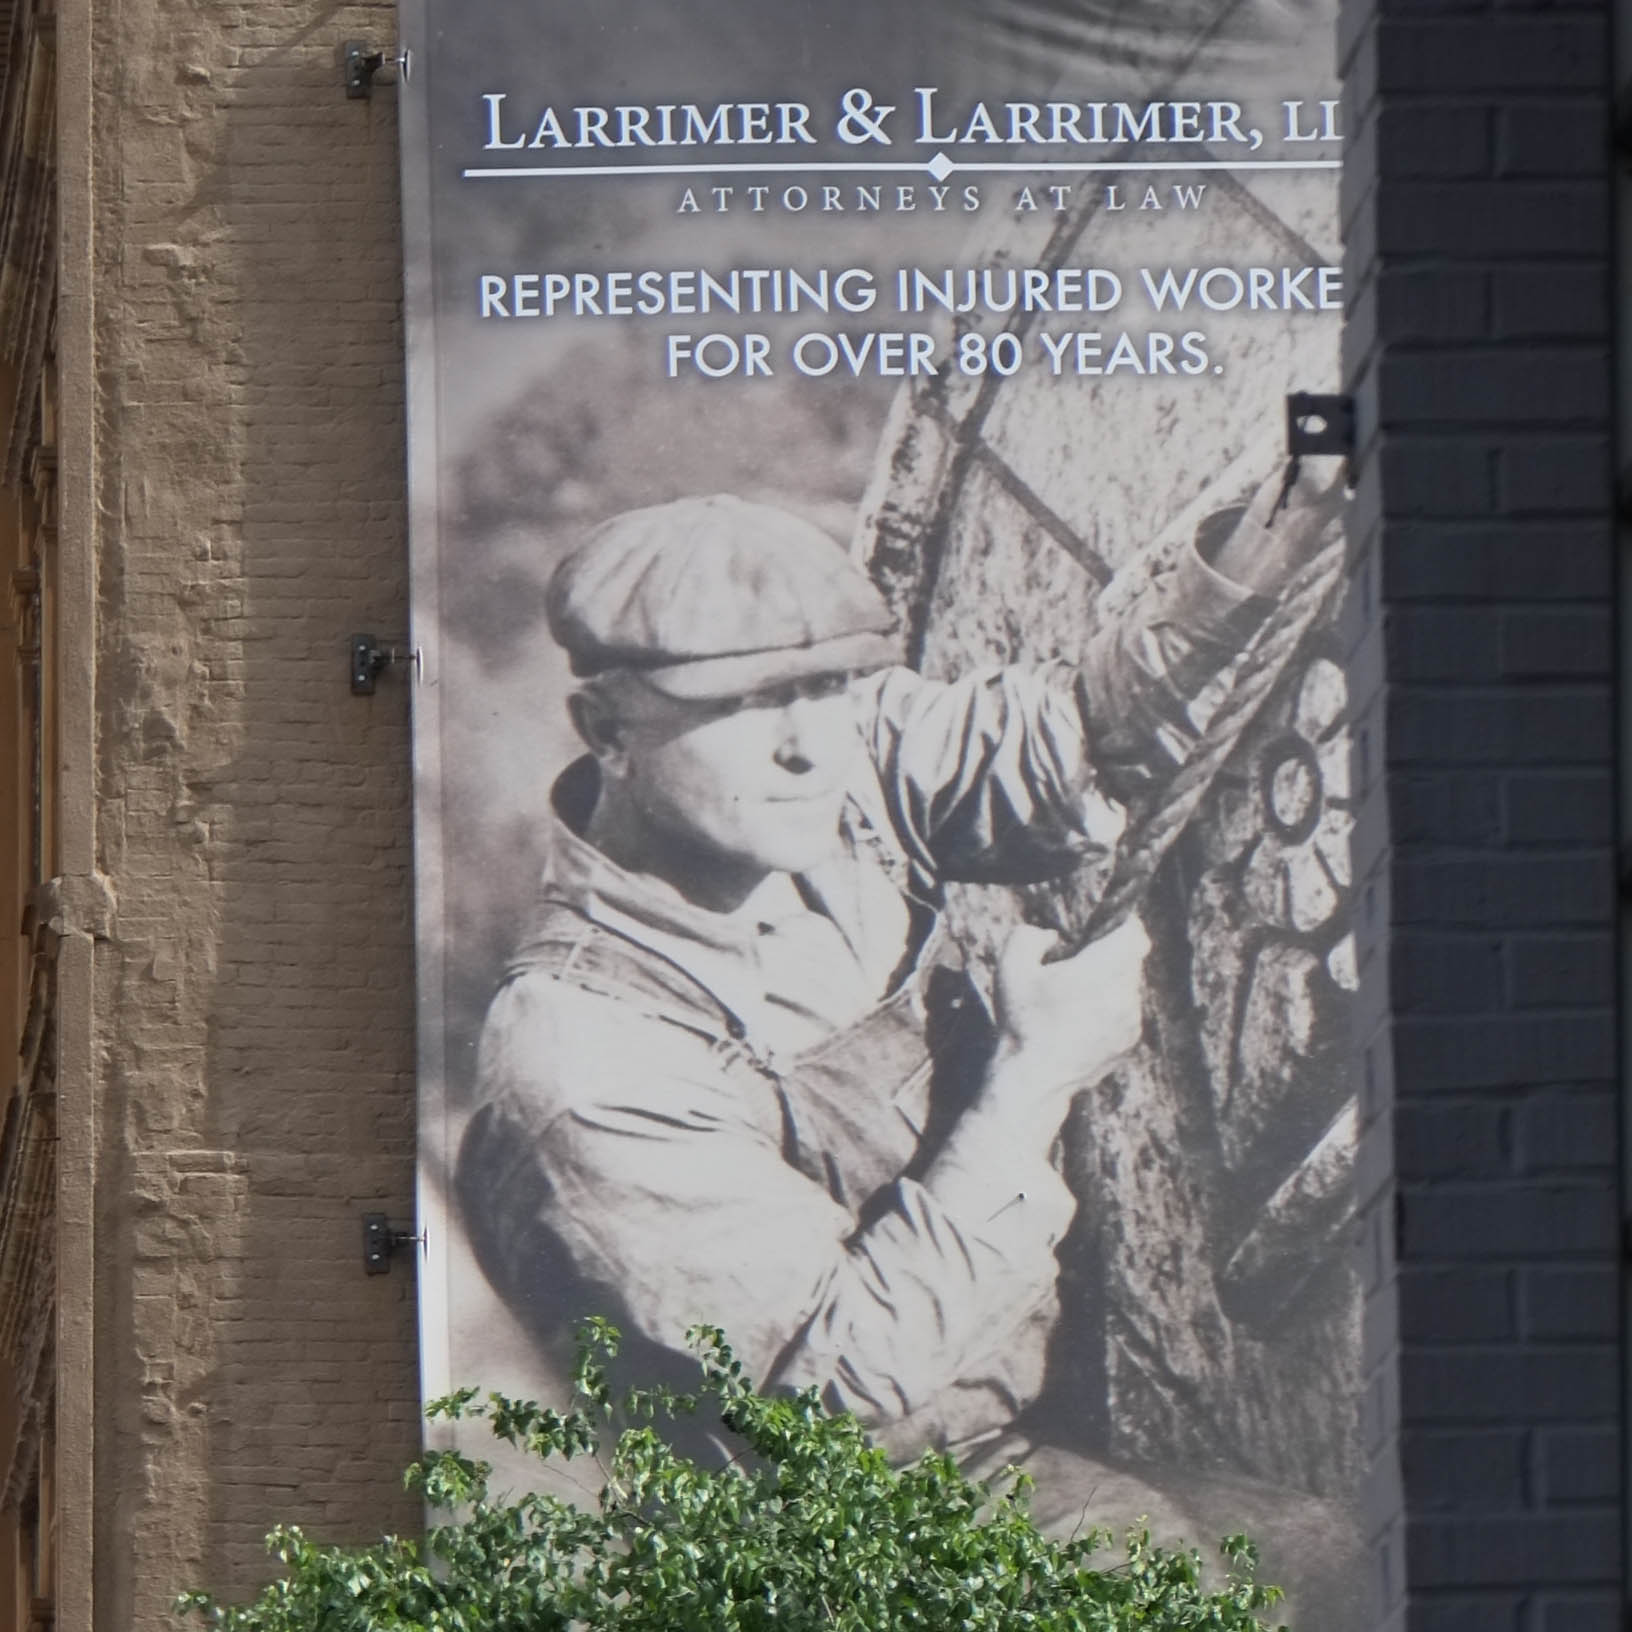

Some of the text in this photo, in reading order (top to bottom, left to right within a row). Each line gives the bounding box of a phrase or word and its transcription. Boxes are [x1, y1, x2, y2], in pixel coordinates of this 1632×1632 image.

[483, 94, 817, 149] LARRIMER
[838, 88, 896, 145] &
[915, 87, 1263, 150] LARRIMER,
[676, 184, 1206, 214] ATTORNEYS AT LAW
[481, 268, 877, 318] REPRESENTING
[898, 267, 1123, 315] INJURED
[668, 330, 1224, 378] FOR OVER 80 YEARS.
